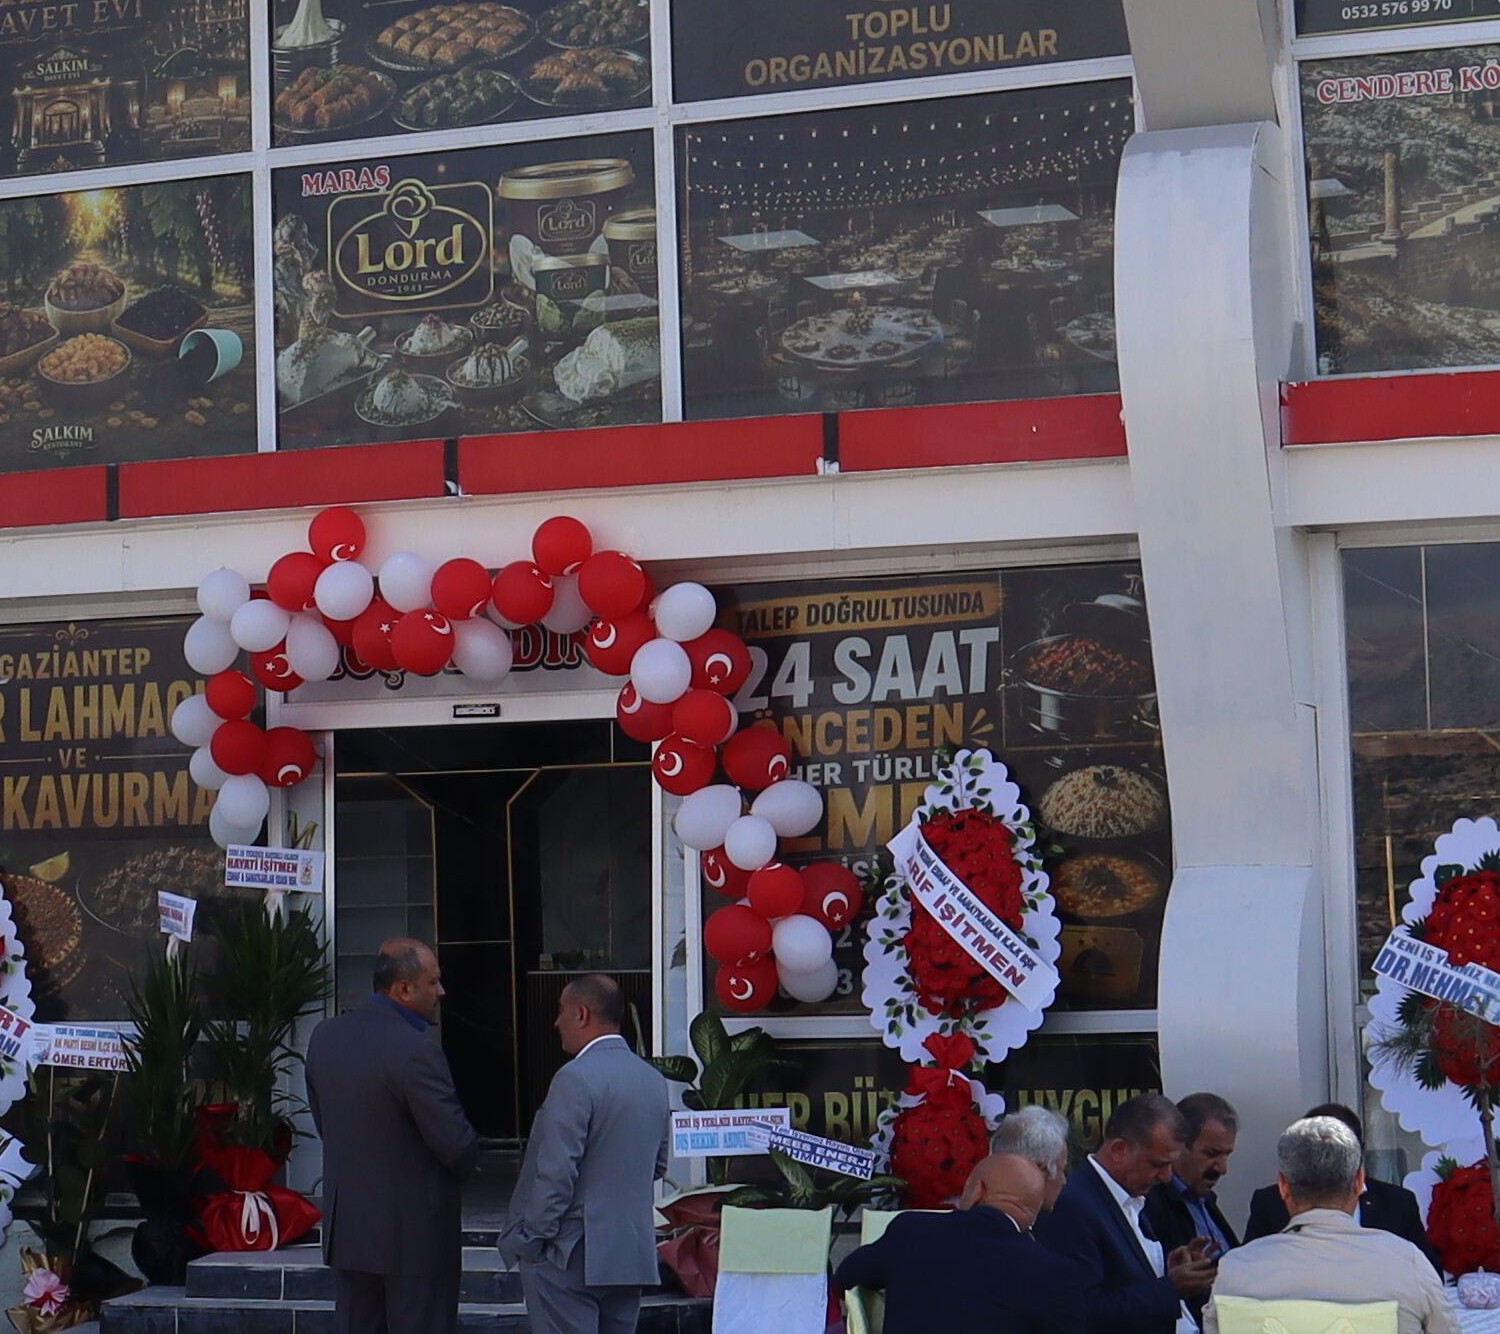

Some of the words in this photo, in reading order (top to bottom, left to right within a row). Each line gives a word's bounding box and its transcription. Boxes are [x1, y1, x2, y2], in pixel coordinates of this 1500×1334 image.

[846, 3, 950, 41] TOPLU
[1341, 3, 1379, 20] 0532
[1381, 1, 1409, 16] 576
[1411, 0, 1431, 14] 99
[36, 58, 89, 75] SALKIM
[744, 28, 1059, 87] ORGANİZASYONLAR
[1317, 69, 1453, 104] CENDERE
[301, 165, 391, 197] MARAŞ
[355, 223, 465, 275] Lord
[366, 269, 453, 287] DONDURMA
[31, 425, 93, 449] SALKIM
[736, 605, 799, 633] TALEP
[806, 590, 983, 627] DOĞRULTUSUNDA
[733, 641, 815, 713] 24
[831, 626, 1000, 705] SAAT
[19, 680, 206, 743] LAHMAC
[58, 747, 87, 769] VE
[228, 857, 258, 871] HAYATİ
[53, 1051, 85, 1067] ÖMER
[88, 1055, 129, 1069] ERTÜR
